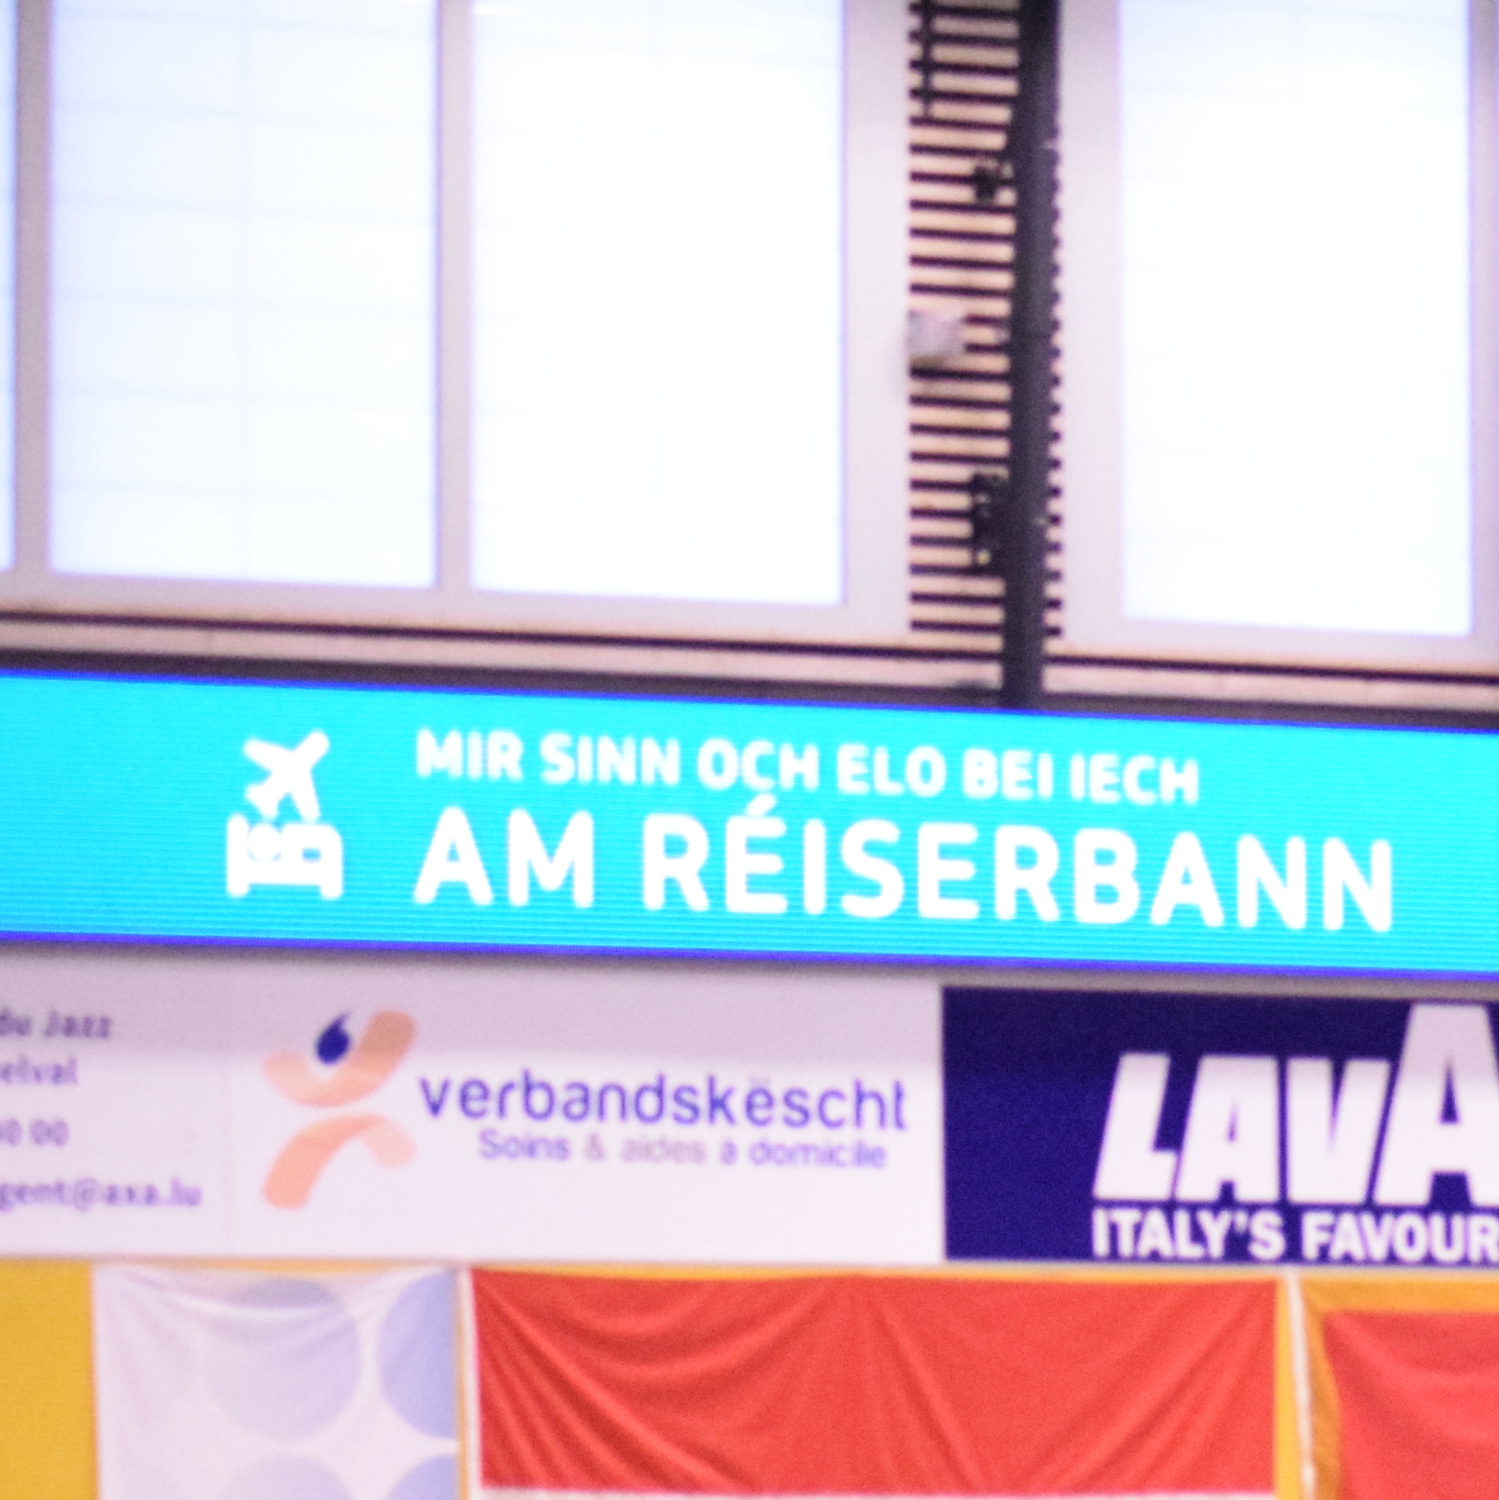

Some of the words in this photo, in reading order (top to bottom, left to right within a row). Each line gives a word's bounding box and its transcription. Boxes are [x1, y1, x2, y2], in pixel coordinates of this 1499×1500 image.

[416, 727, 524, 782] MIR
[540, 731, 681, 786] SINN
[697, 738, 820, 792] OCH
[836, 743, 947, 799] ELO
[961, 747, 1054, 801] BEI
[1070, 752, 1199, 807] IECH
[414, 805, 595, 909] AM
[642, 792, 1393, 934] RÉISERBANN
[44, 1010, 112, 1038] Jazz
[479, 1129, 571, 1162] Soins
[621, 1133, 706, 1164] aides
[748, 1137, 888, 1169] domicile
[1092, 1207, 1286, 1261] ITALY'S
